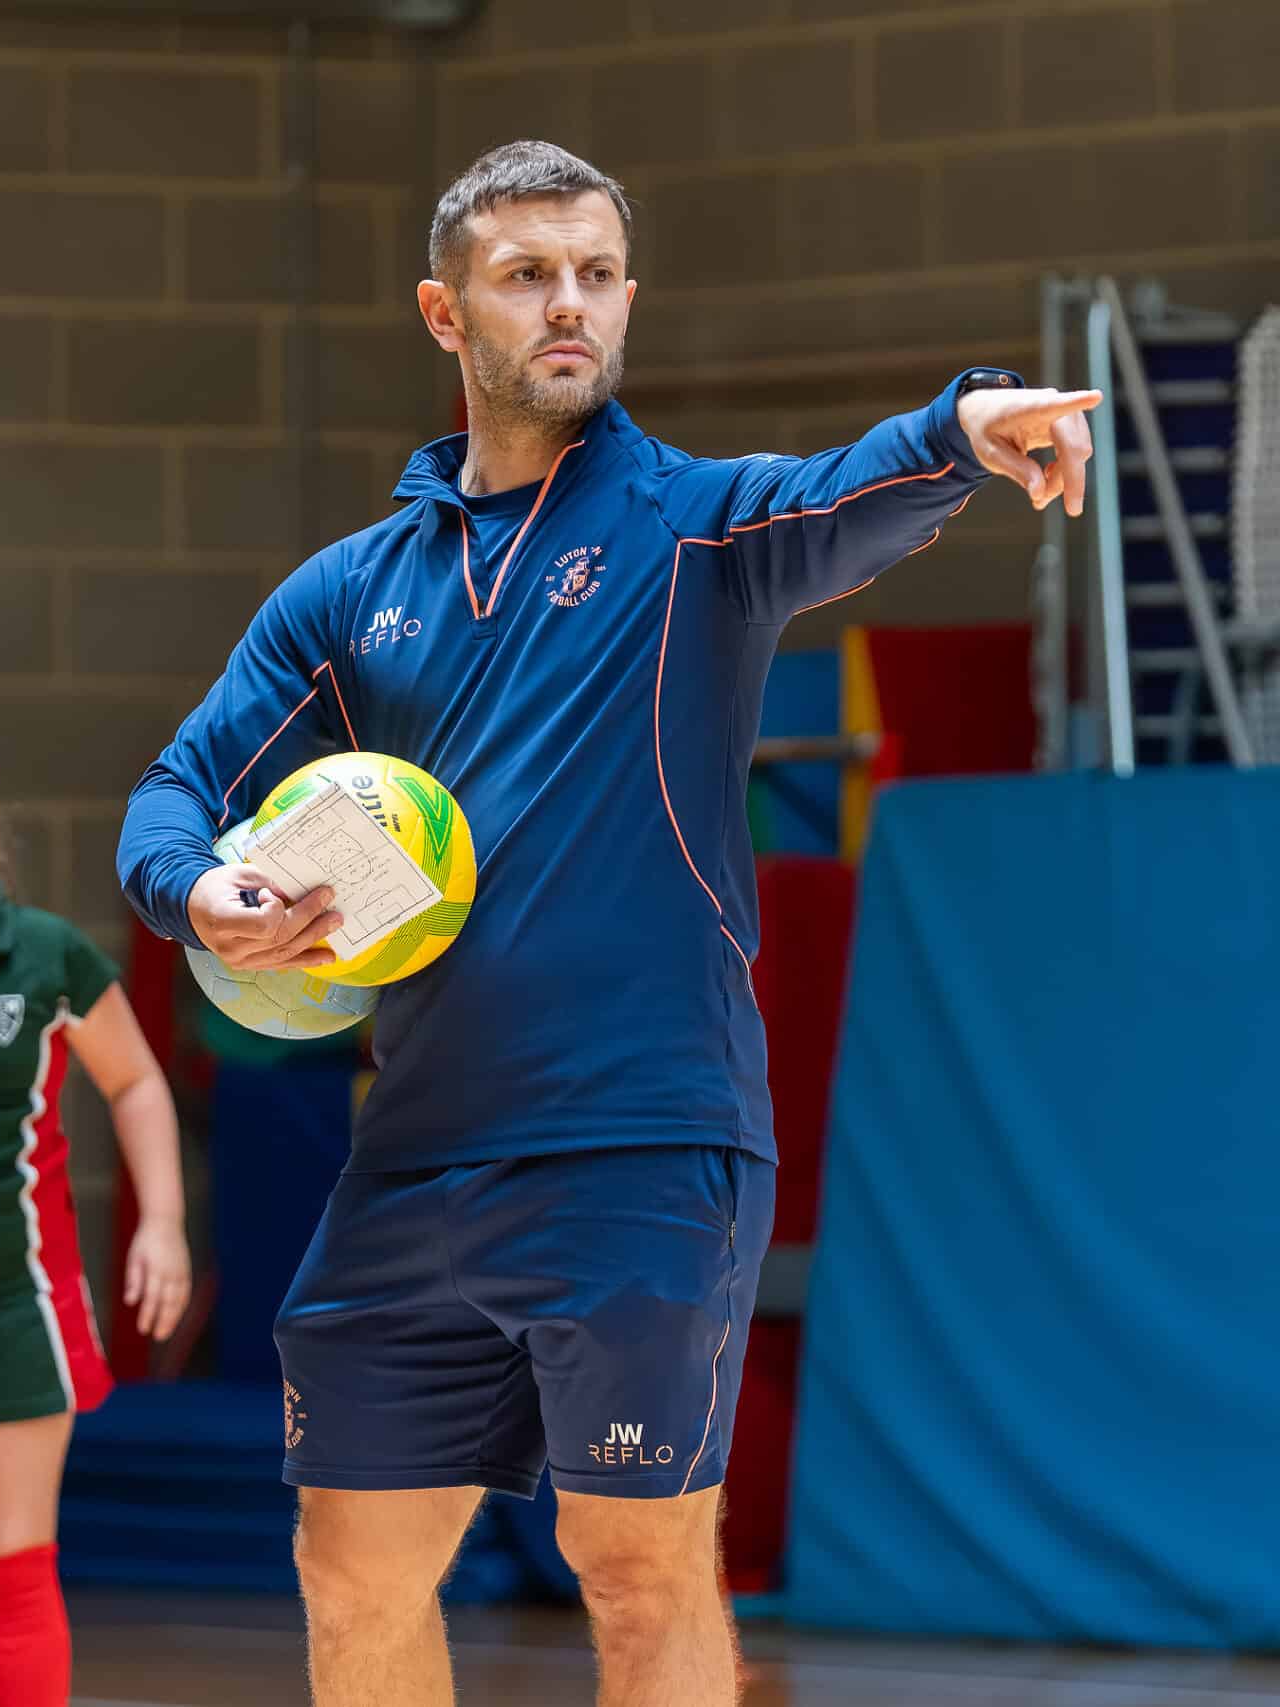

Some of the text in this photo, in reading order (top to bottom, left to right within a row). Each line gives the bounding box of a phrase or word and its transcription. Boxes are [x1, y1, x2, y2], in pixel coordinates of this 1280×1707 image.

[553, 546, 587, 568] LUTON
[580, 580, 601, 602] CLUB
[367, 606, 403, 632] JW
[349, 618, 422, 657] REFLO
[351, 776, 387, 827] tre
[605, 1423, 644, 1445] JW
[588, 1445, 674, 1465] REFLO
